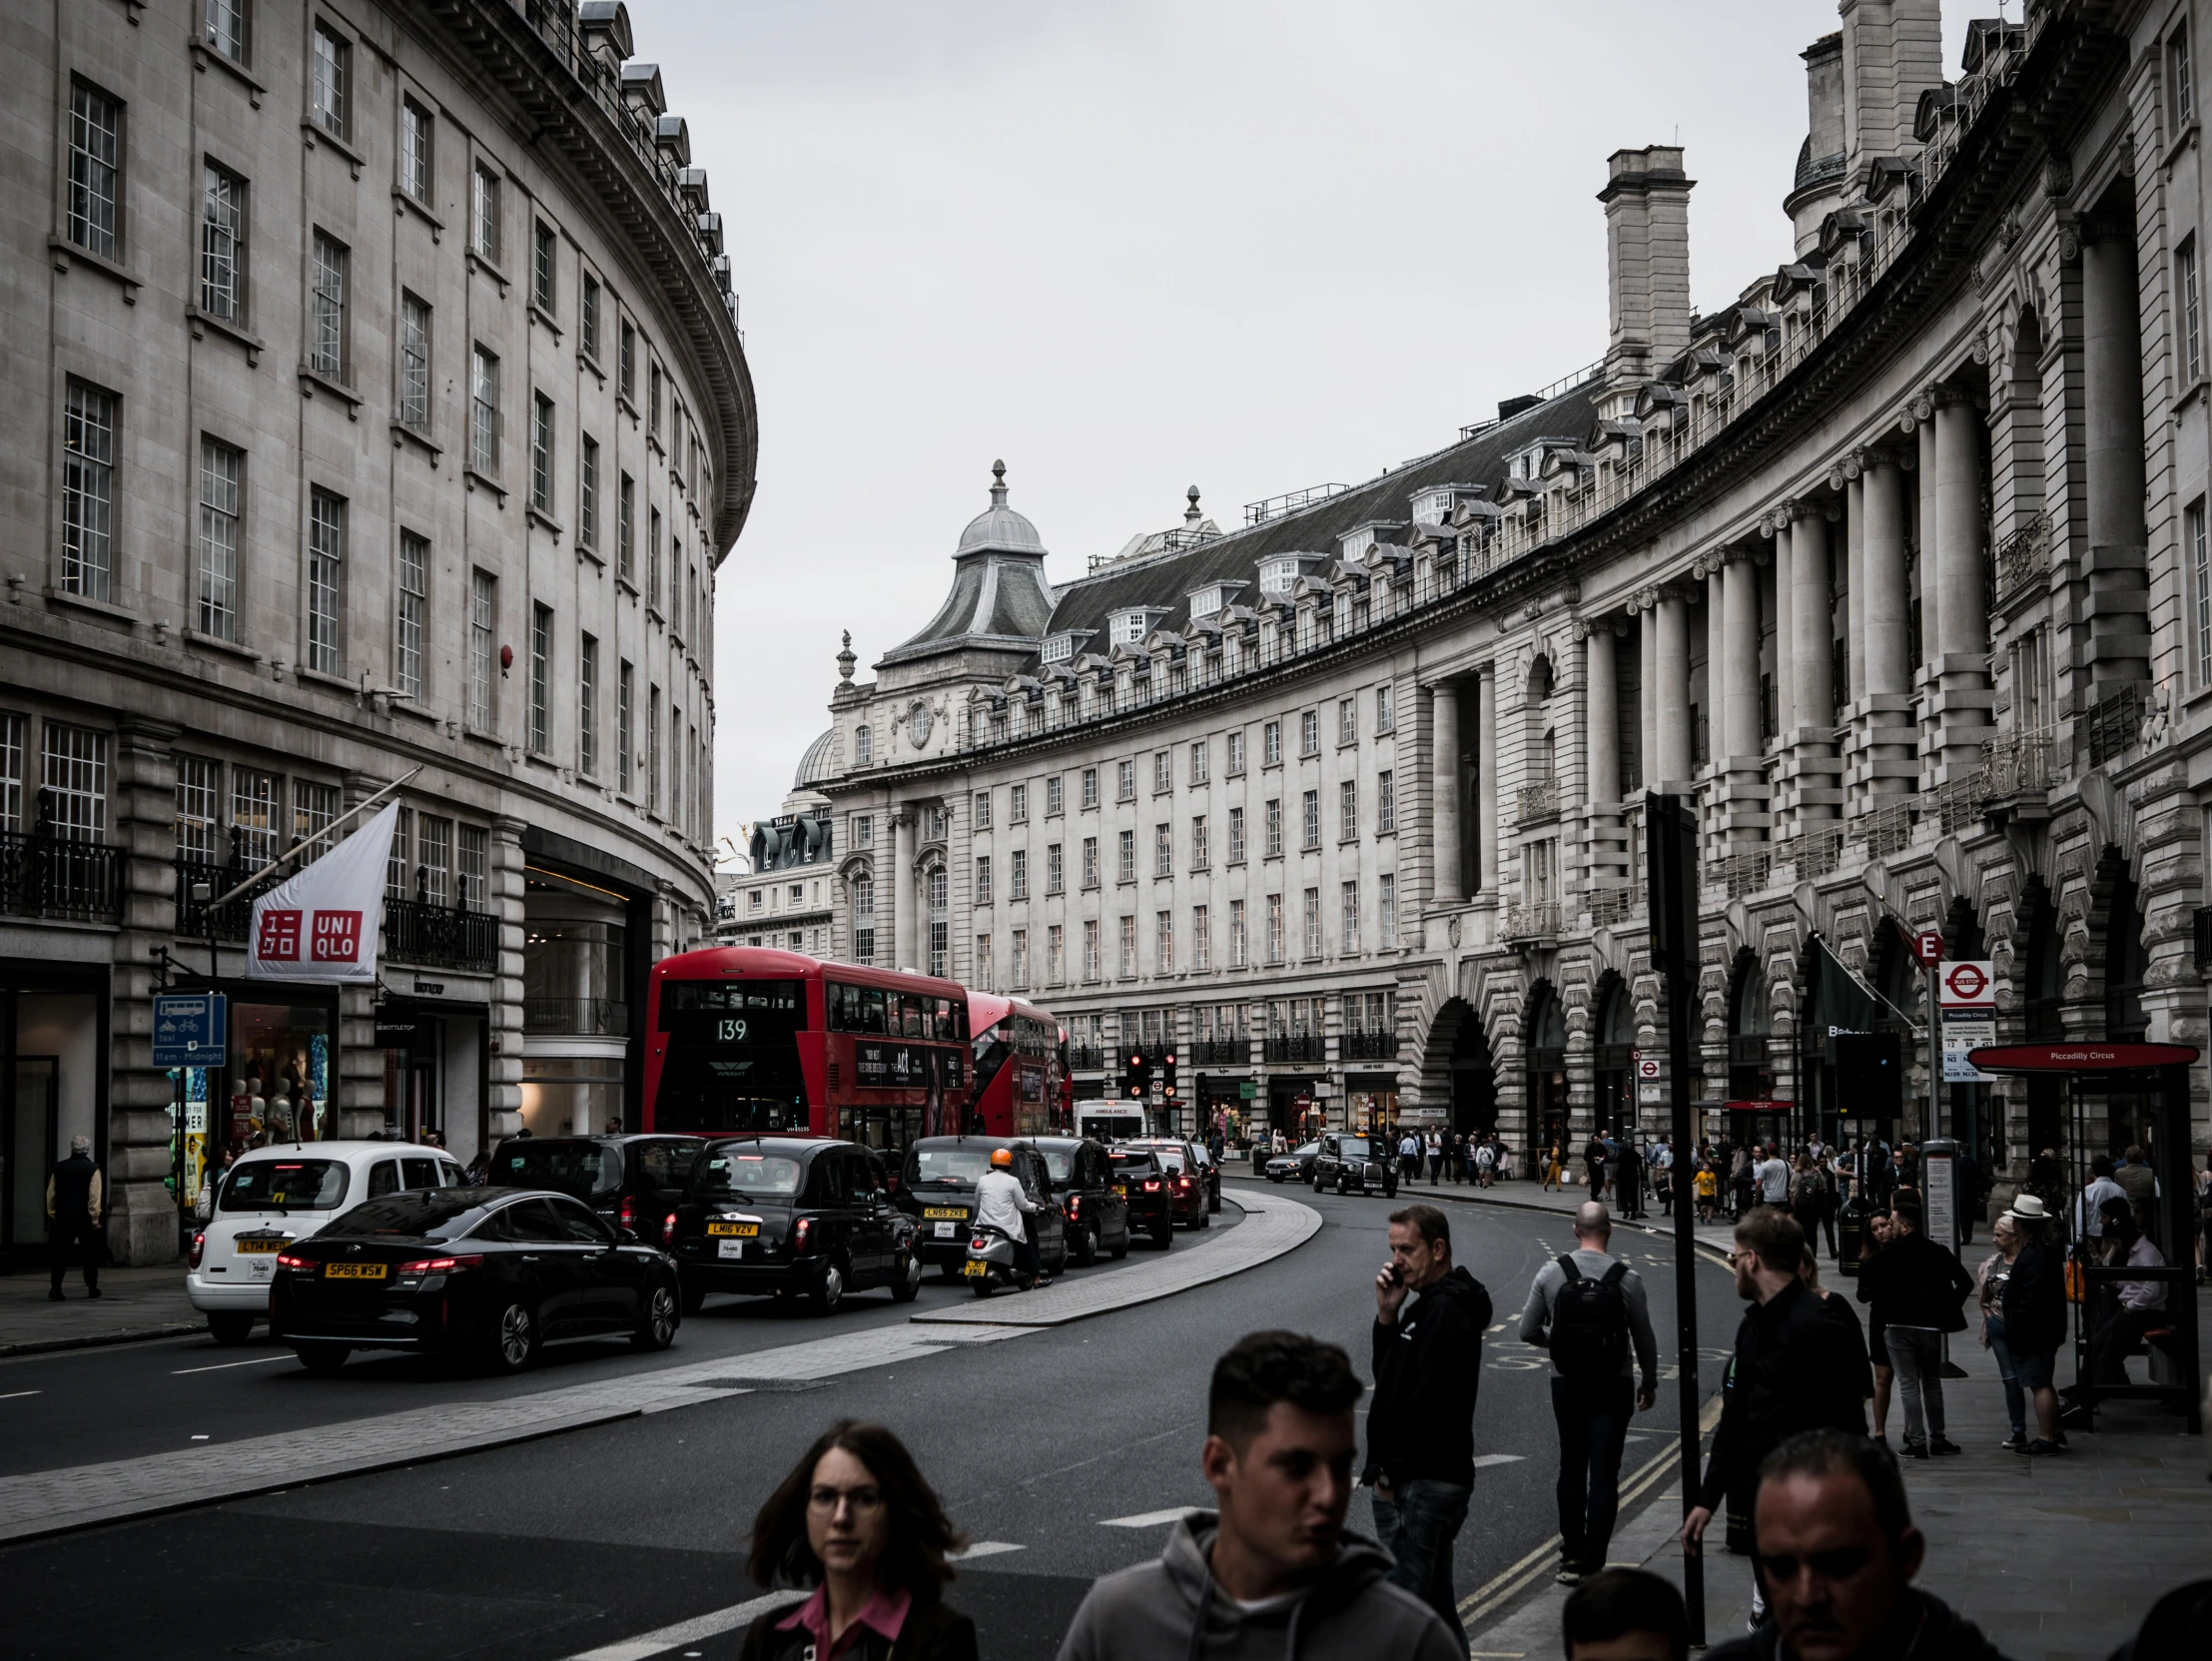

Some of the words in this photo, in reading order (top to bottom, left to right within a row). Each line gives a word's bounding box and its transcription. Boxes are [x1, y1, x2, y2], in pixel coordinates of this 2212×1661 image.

[318, 916, 353, 935] UNI
[316, 937, 354, 959] QLO
[1921, 936, 1937, 958] E
[719, 1019, 747, 1041] 139
[159, 1034, 176, 1043] taxi
[156, 1053, 178, 1062] 11am
[184, 1052, 223, 1062] Midnight
[1633, 1051, 1641, 1060] D
[2050, 1052, 2088, 1061] Piccadilly
[713, 1225, 733, 1234] LM16
[735, 1225, 754, 1235] VZV
[243, 1242, 265, 1251] LT14
[331, 1264, 358, 1276] SP66
[361, 1264, 382, 1277] WSW
